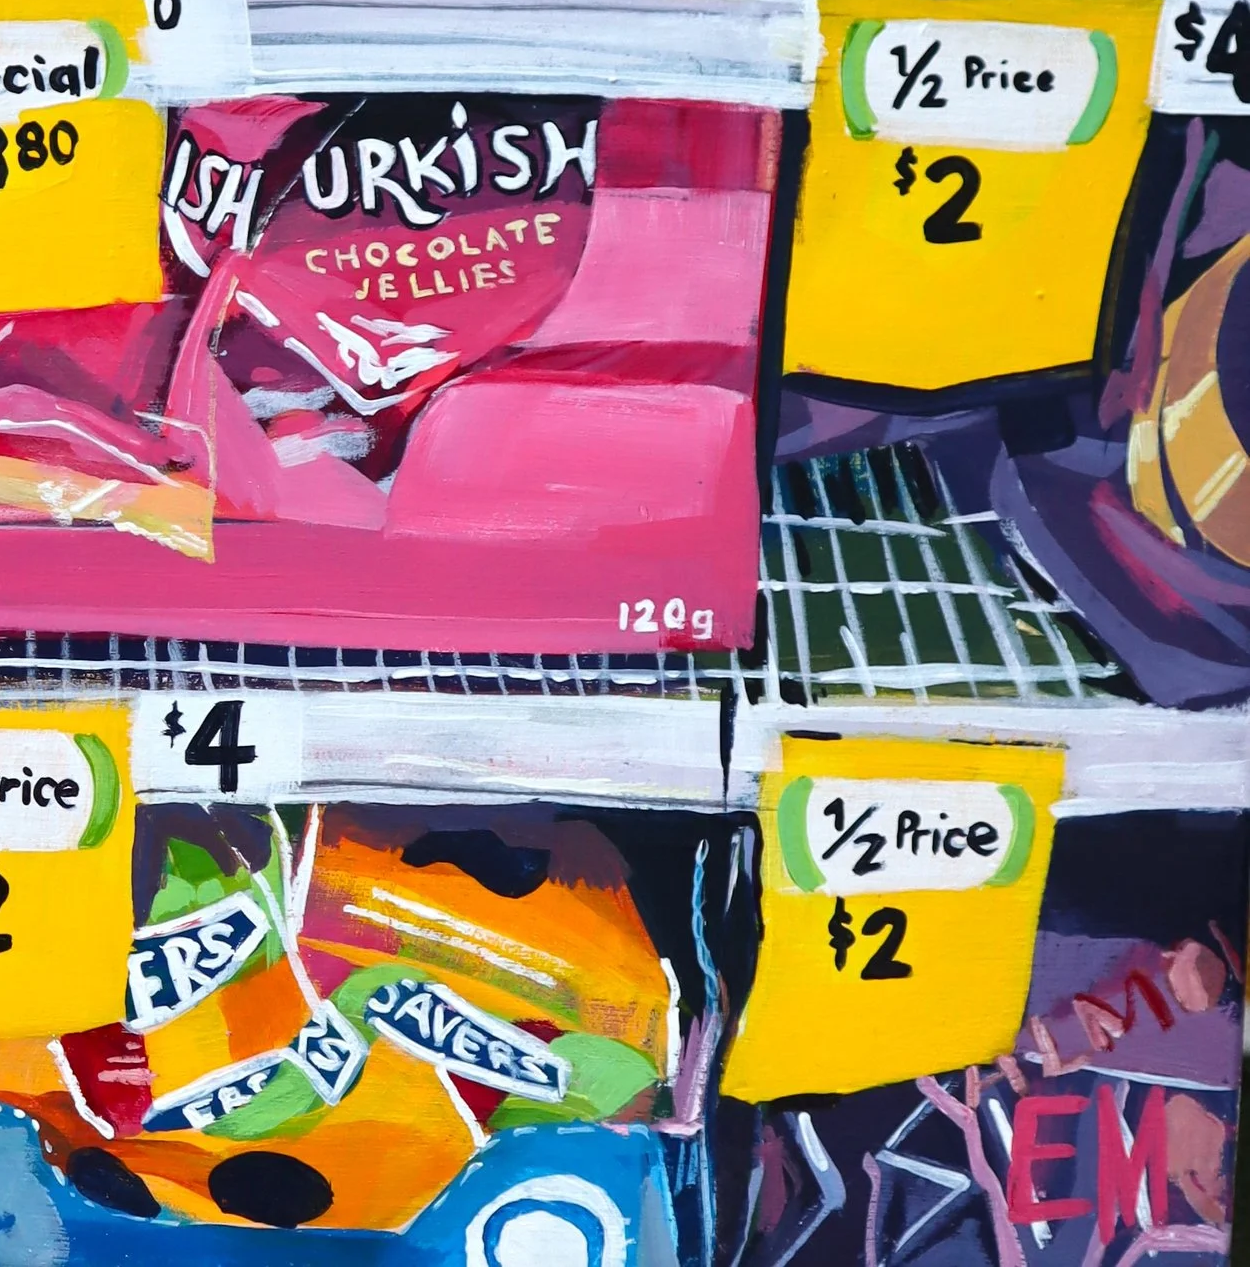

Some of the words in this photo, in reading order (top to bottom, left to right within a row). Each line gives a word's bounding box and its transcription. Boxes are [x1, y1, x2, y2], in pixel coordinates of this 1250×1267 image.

[965, 59, 1055, 93] Price
[893, 146, 982, 244] $2
[305, 213, 562, 275] CHOCOLATE
[355, 259, 518, 301] JELLIES
[619, 598, 714, 641] 120g
[162, 700, 258, 792] $4
[896, 809, 1000, 858] Price
[828, 896, 913, 981] $2
